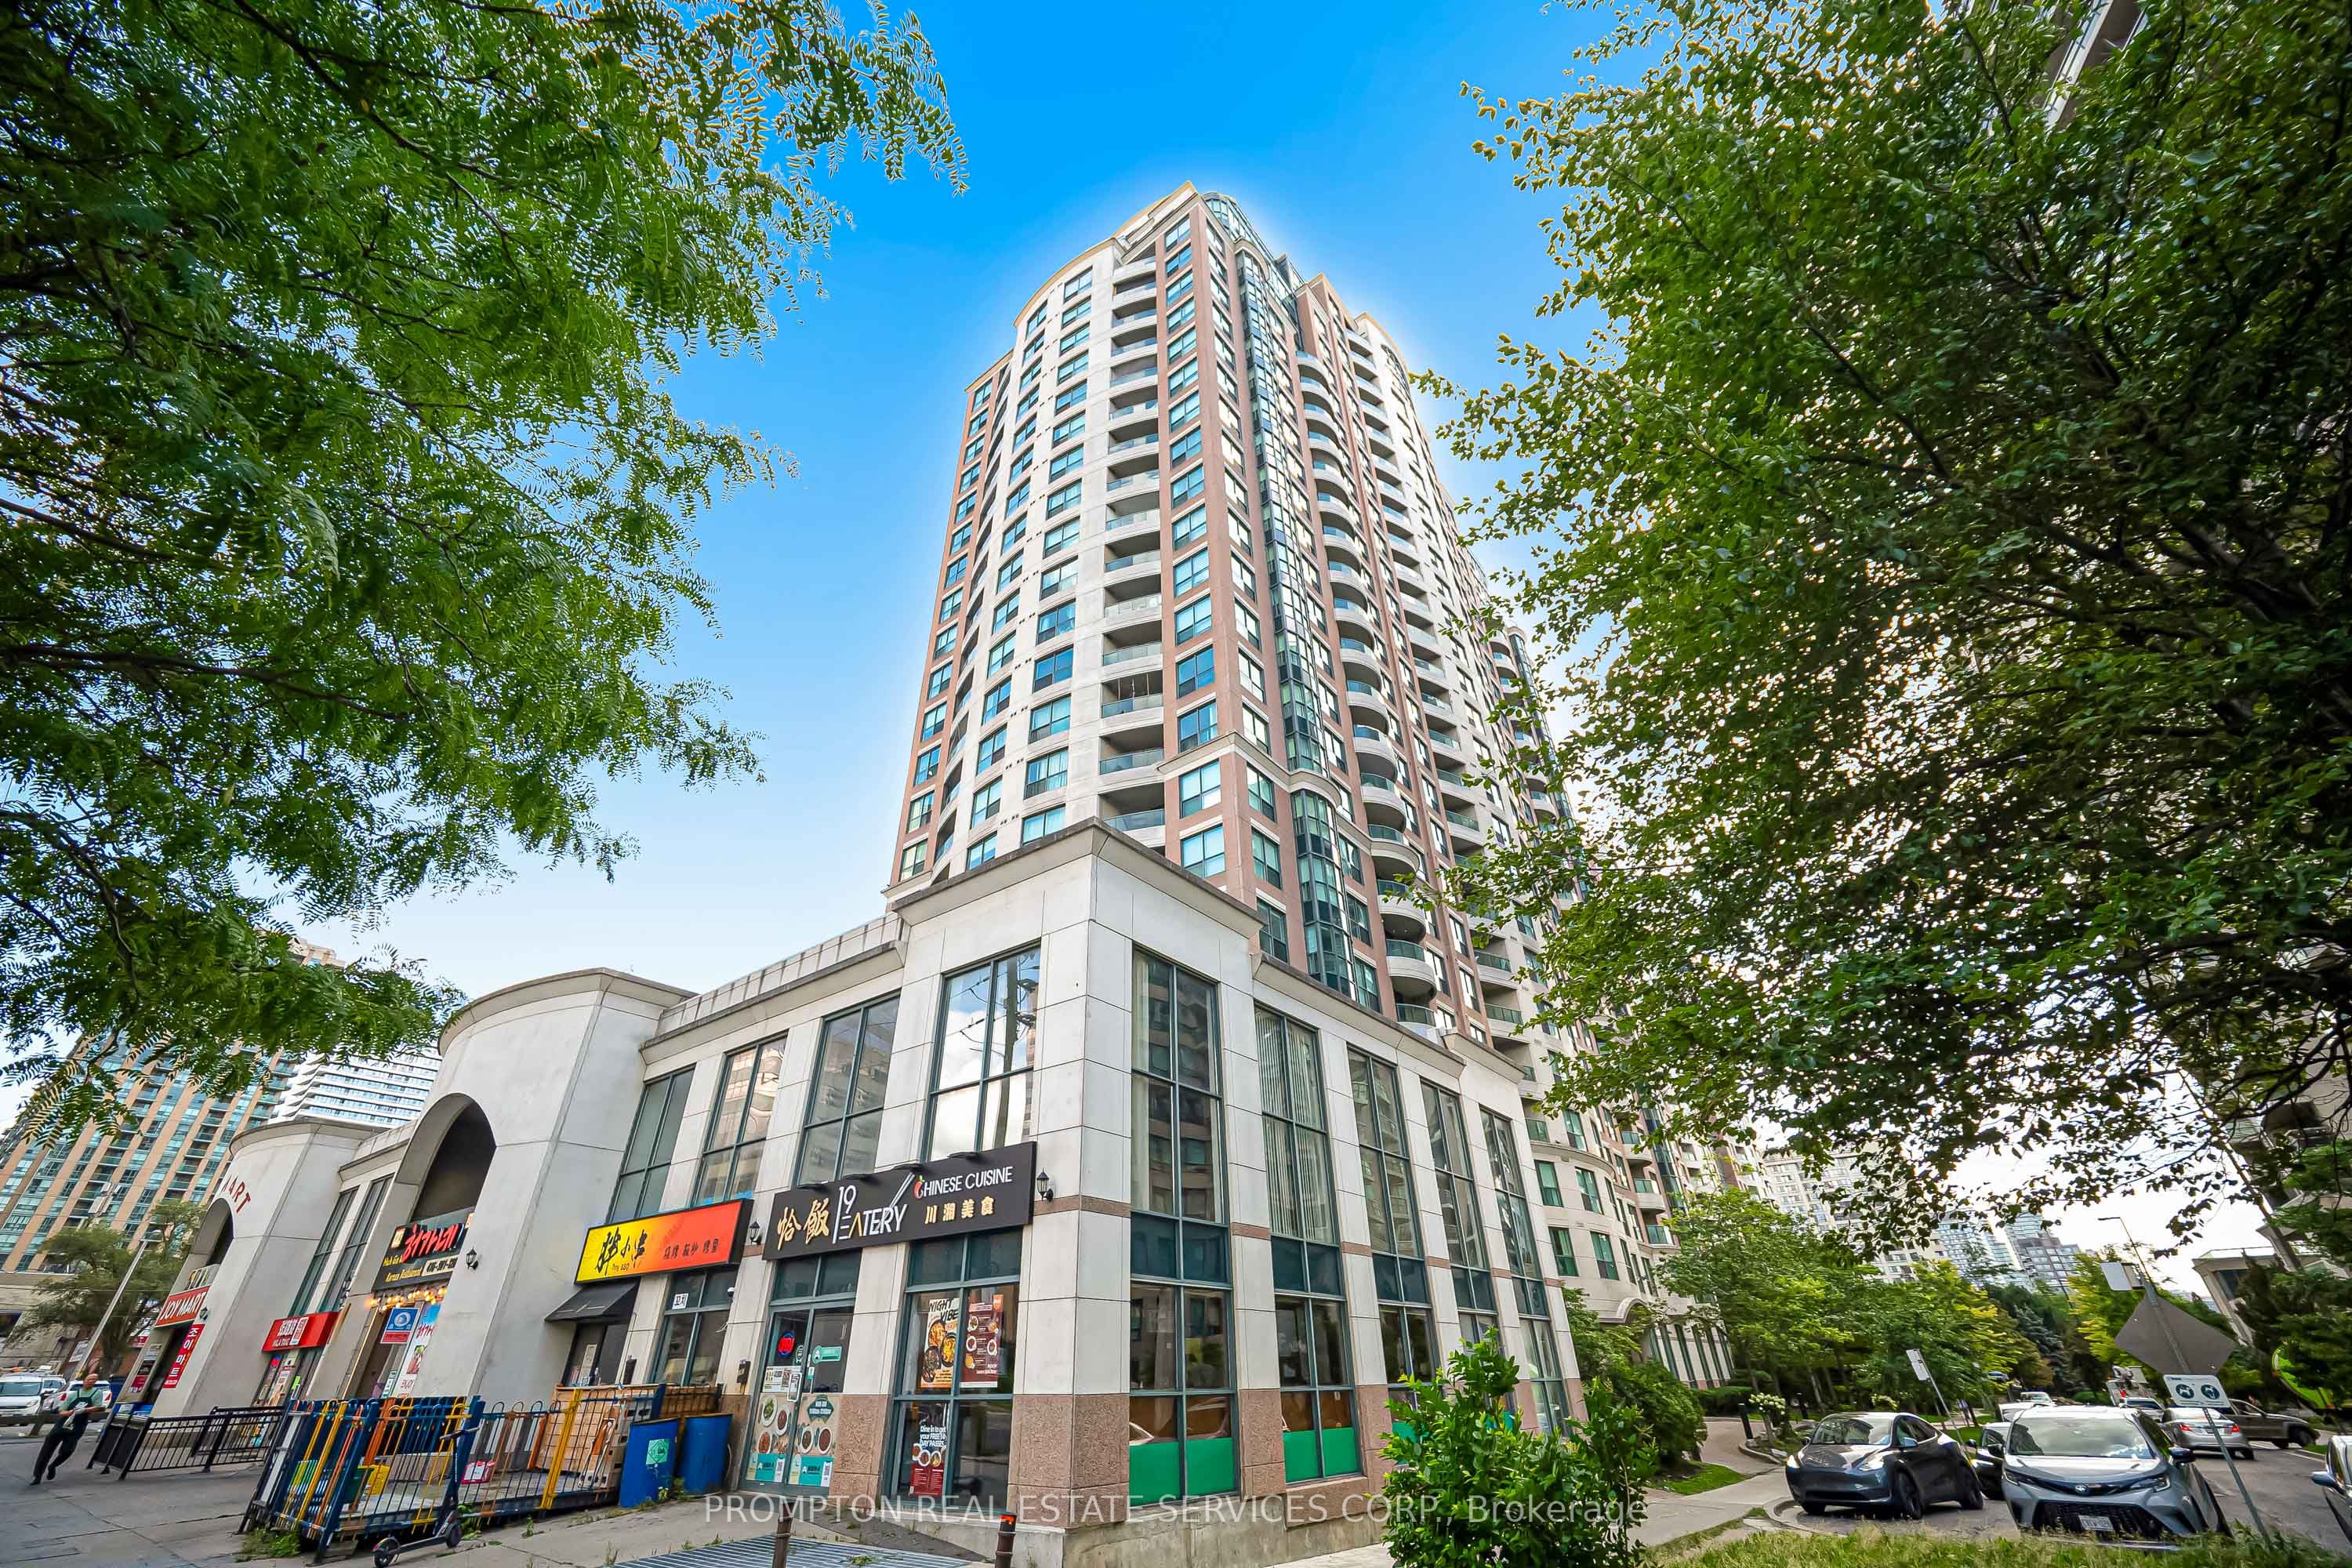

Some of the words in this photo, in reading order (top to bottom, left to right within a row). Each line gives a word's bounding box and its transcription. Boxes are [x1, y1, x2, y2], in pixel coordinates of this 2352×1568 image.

[913, 1175, 964, 1199] CHINESE
[965, 1166, 1014, 1189] CUISINE
[924, 1196, 994, 1225] 川湘美食
[160, 1299, 181, 1321] JOY
[180, 1291, 208, 1316] MART
[929, 1298, 953, 1312] NIGHT
[940, 1308, 959, 1323] VIBE
[169, 1327, 201, 1378] 조이마트
